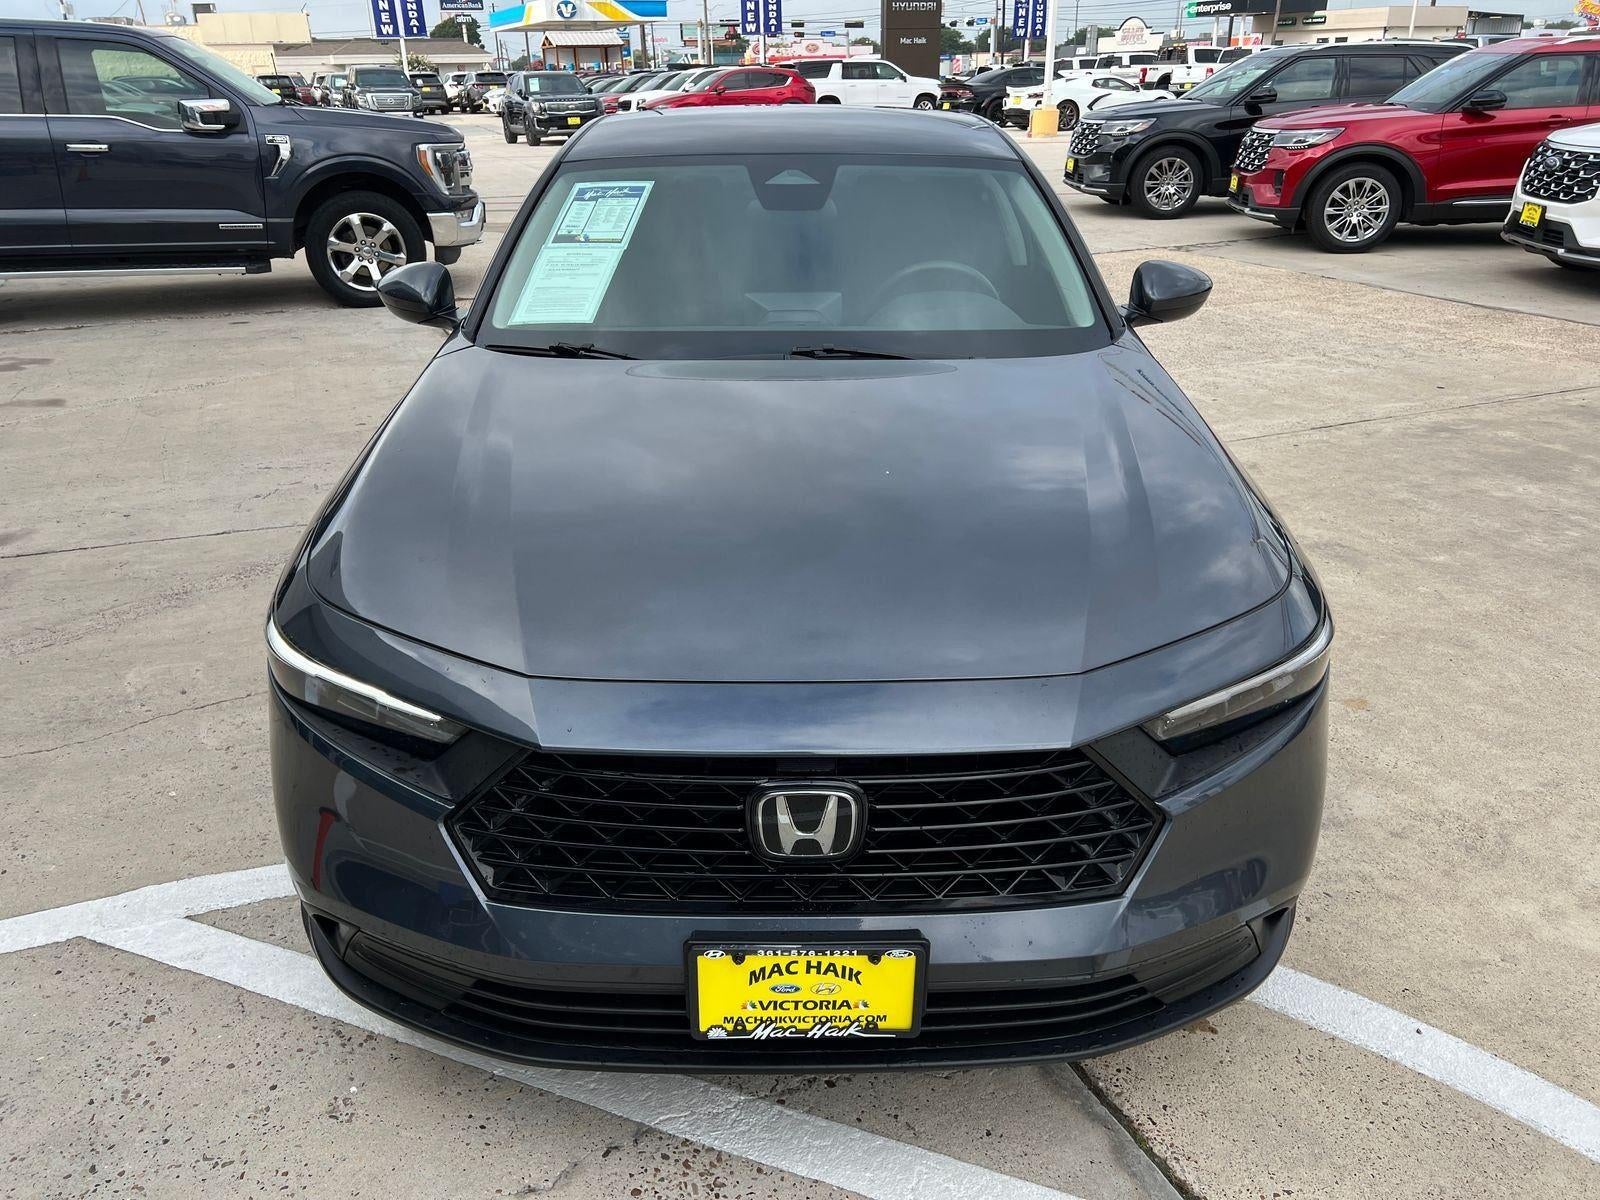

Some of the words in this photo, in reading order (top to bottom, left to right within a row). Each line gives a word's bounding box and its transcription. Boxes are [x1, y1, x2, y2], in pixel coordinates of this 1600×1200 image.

[891, 2, 937, 11] HYUNDAI
[1189, 2, 1232, 14] enterprise
[378, 0, 394, 35] NEW
[406, 0, 420, 34] NDAI
[456, 15, 473, 23] atm
[745, 2, 757, 33] NEW
[1015, 7, 1027, 37] NEW
[748, 960, 799, 987] MAC
[805, 960, 863, 986] HAIK
[773, 984, 798, 994] Ford
[758, 1000, 853, 1011] VICTORIA
[723, 1014, 887, 1024] MACHAIKVICTORIA.COM
[749, 1022, 806, 1040] Mac
[806, 1021, 866, 1039] Haik
